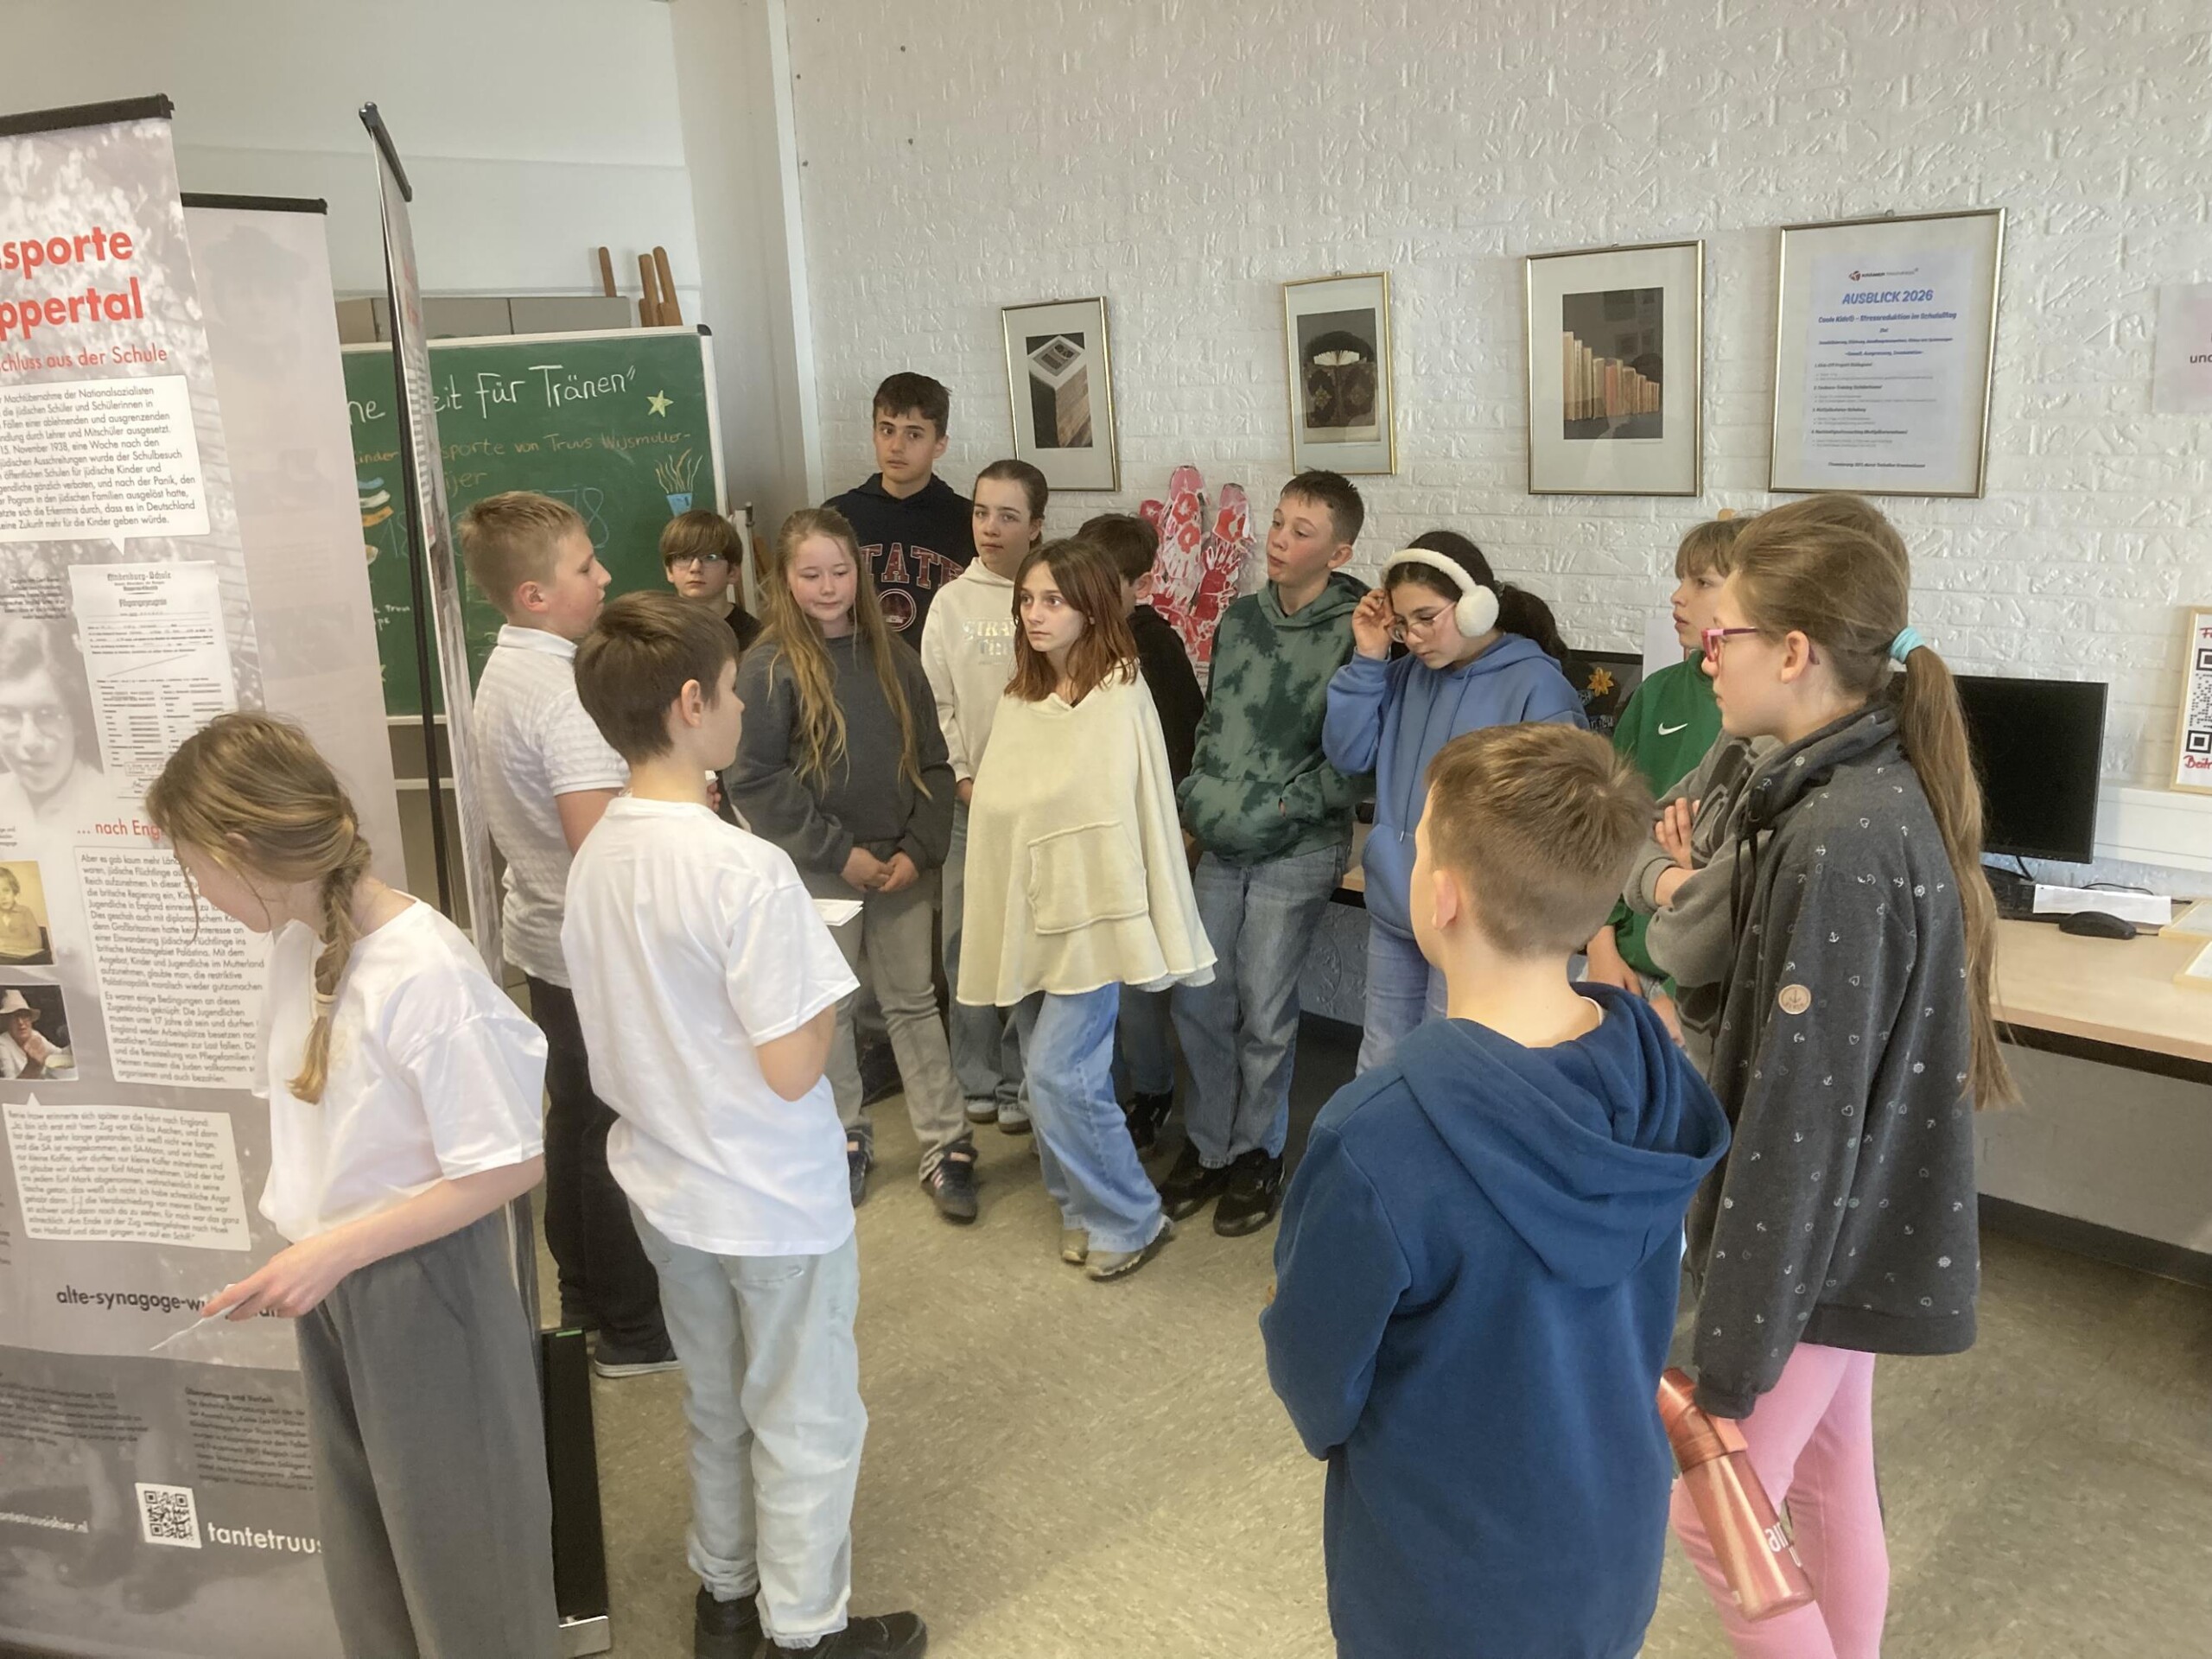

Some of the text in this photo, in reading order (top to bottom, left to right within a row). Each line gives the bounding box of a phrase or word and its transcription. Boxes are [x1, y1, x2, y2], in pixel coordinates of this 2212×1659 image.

[0, 226, 133, 279] sporte
[1842, 289, 1934, 305] AUSBLICK 2026
[47, 354, 73, 368] aus
[78, 347, 105, 366] der
[112, 342, 168, 365] Schule
[64, 389, 76, 399] der
[79, 386, 154, 397] Nationalsozialisten
[432, 375, 461, 412] eit
[75, 401, 89, 411] und
[92, 399, 143, 410] Schülerinnen
[146, 398, 153, 407] in
[92, 413, 105, 423] und
[109, 410, 169, 424] ausgrenzenden
[68, 428, 81, 438] und
[85, 426, 123, 436] Mitschüler
[89, 439, 118, 449] Woche
[121, 438, 141, 448] nach
[143, 437, 159, 447] den
[514, 441, 539, 453] von
[89, 453, 114, 462] wurde
[117, 452, 130, 461] der
[133, 448, 182, 461] Schulbesuch
[117, 464, 143, 474] Kinder
[146, 462, 161, 473] und
[98, 478, 112, 487] und
[115, 476, 134, 486] nach
[137, 476, 150, 486] der
[181, 474, 195, 484] den
[92, 490, 124, 500] Familien
[105, 503, 123, 512] dass
[147, 499, 195, 512] Deutschland
[113, 515, 138, 527] geben
[95, 818, 128, 836] nach
[132, 820, 162, 840] Eng
